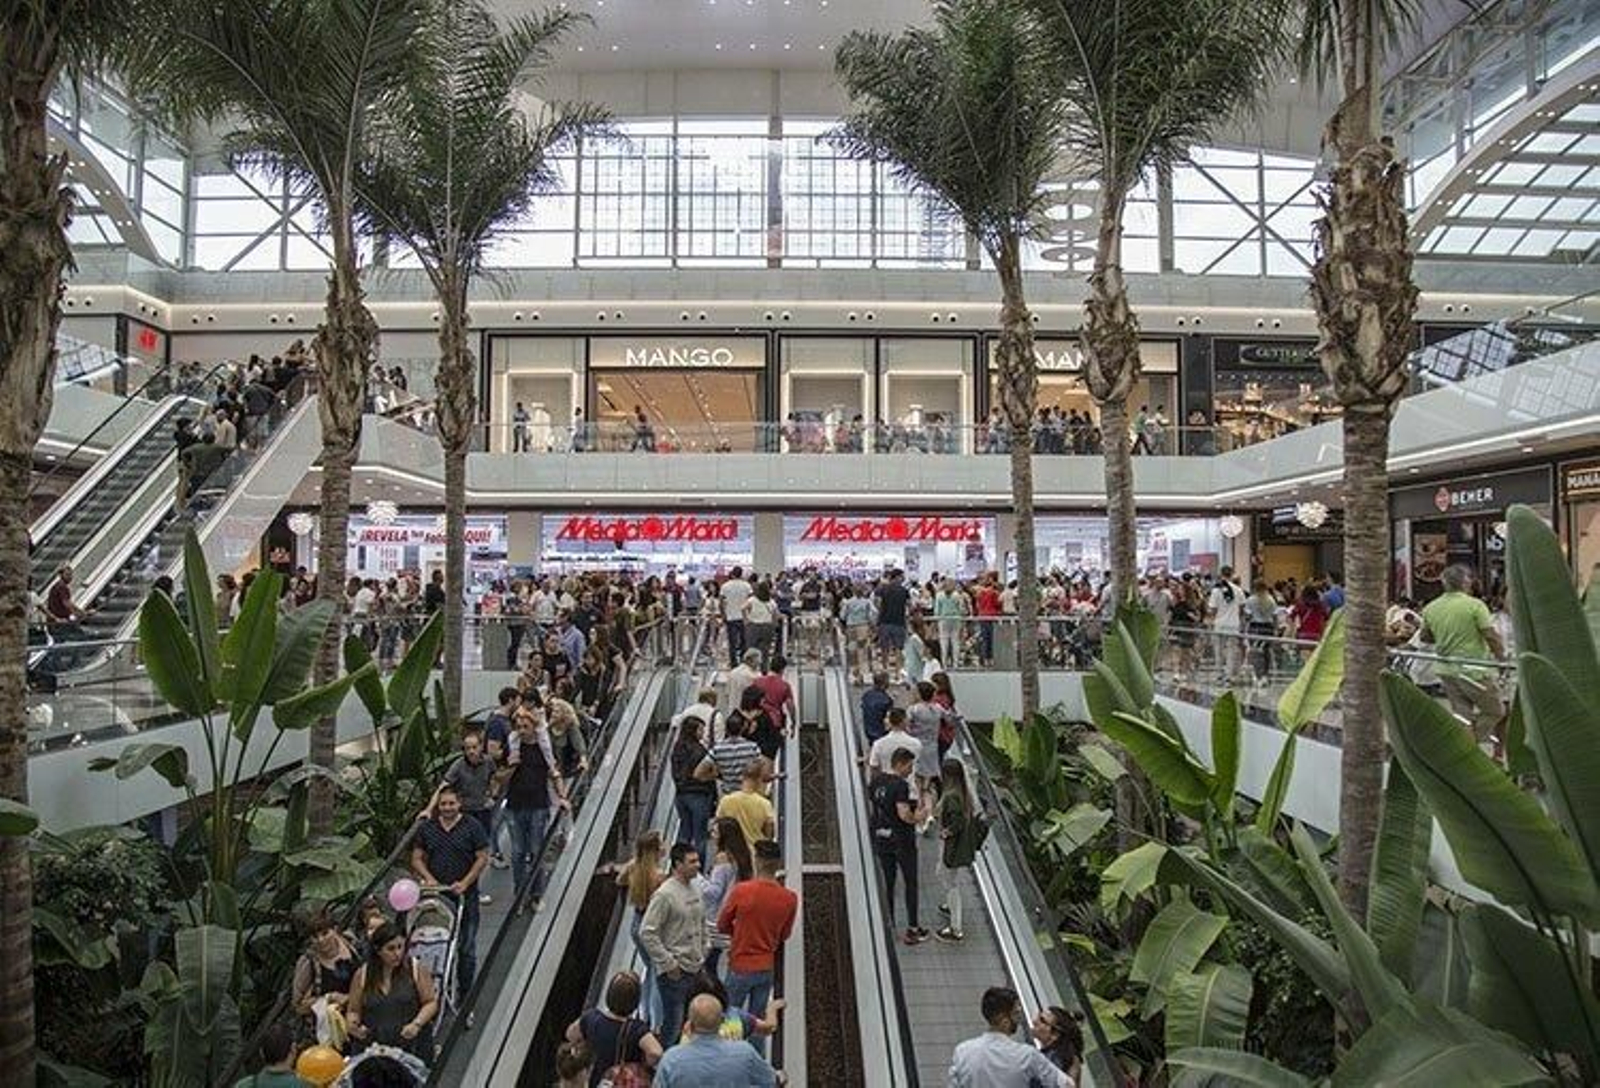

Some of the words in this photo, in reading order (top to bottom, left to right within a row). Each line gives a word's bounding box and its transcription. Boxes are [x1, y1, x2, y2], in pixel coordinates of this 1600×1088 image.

[625, 347, 734, 367] MANGO
[556, 516, 642, 541] Media
[801, 517, 887, 542] Media
[904, 517, 982, 542] Markt
